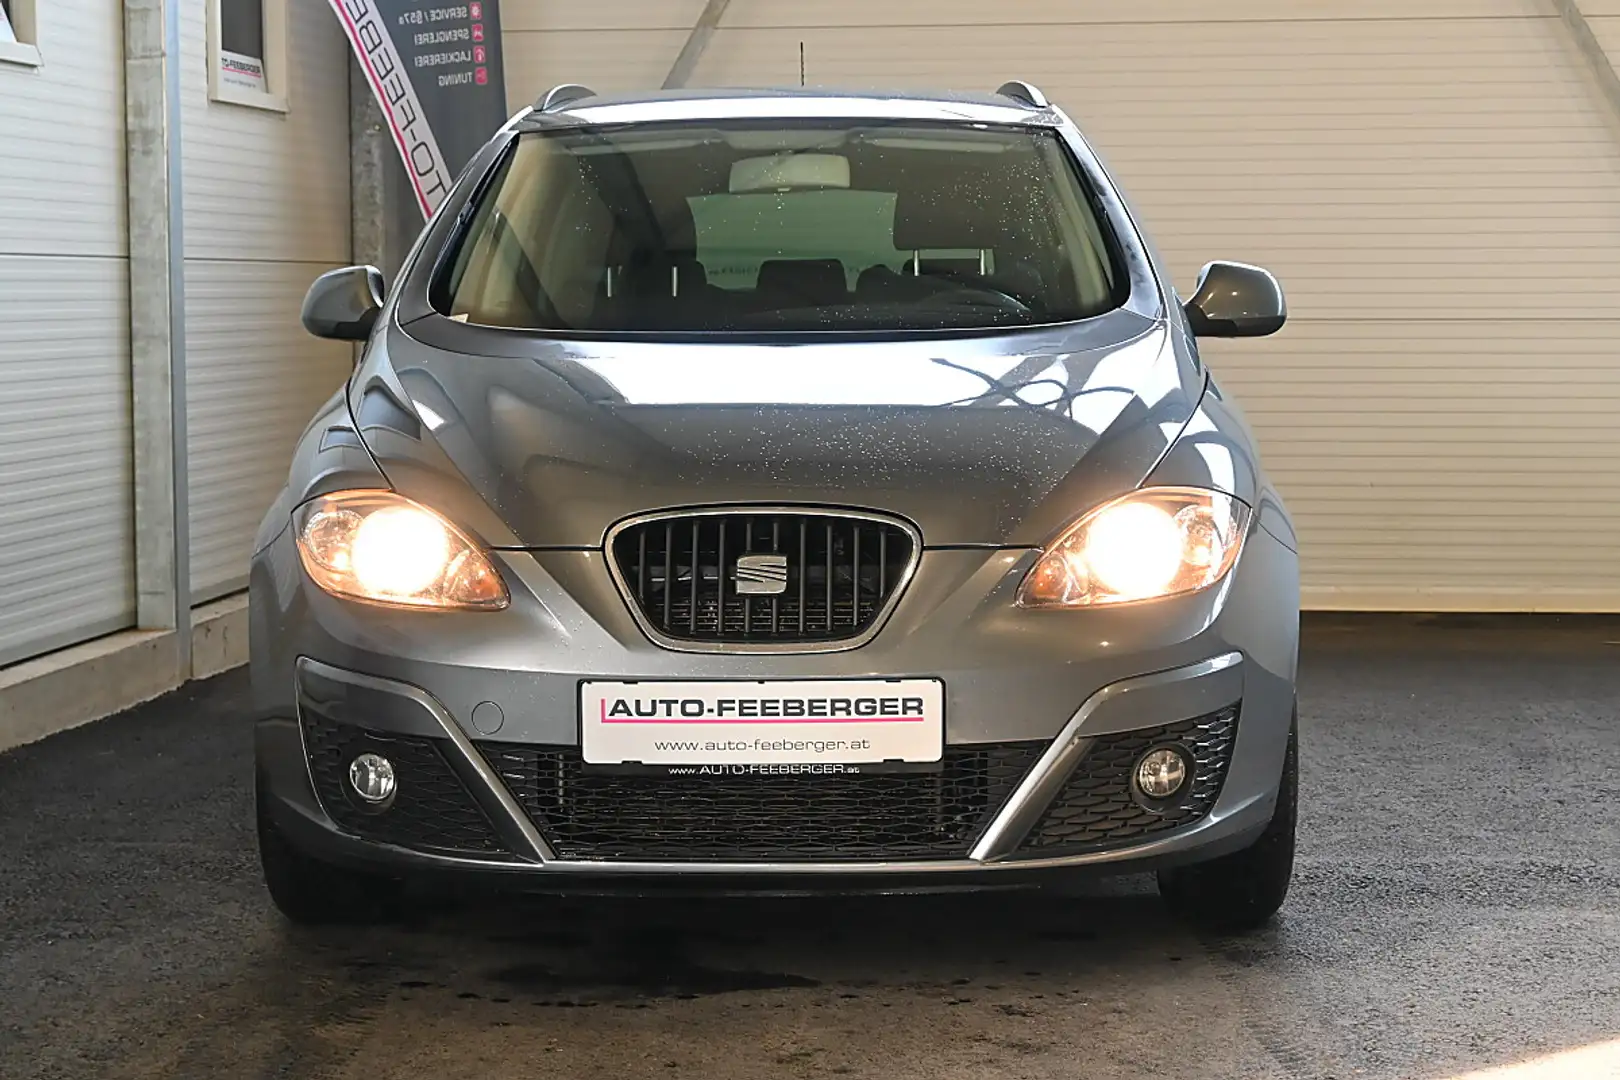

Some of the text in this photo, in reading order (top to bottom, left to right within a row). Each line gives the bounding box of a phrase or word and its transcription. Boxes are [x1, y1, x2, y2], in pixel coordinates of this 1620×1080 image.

[608, 697, 924, 717] AUTO-FEEBERGER
[654, 738, 871, 753] www.auto-feeberger.at
[668, 764, 860, 775] www.AUTO-FEEBERGER.at
